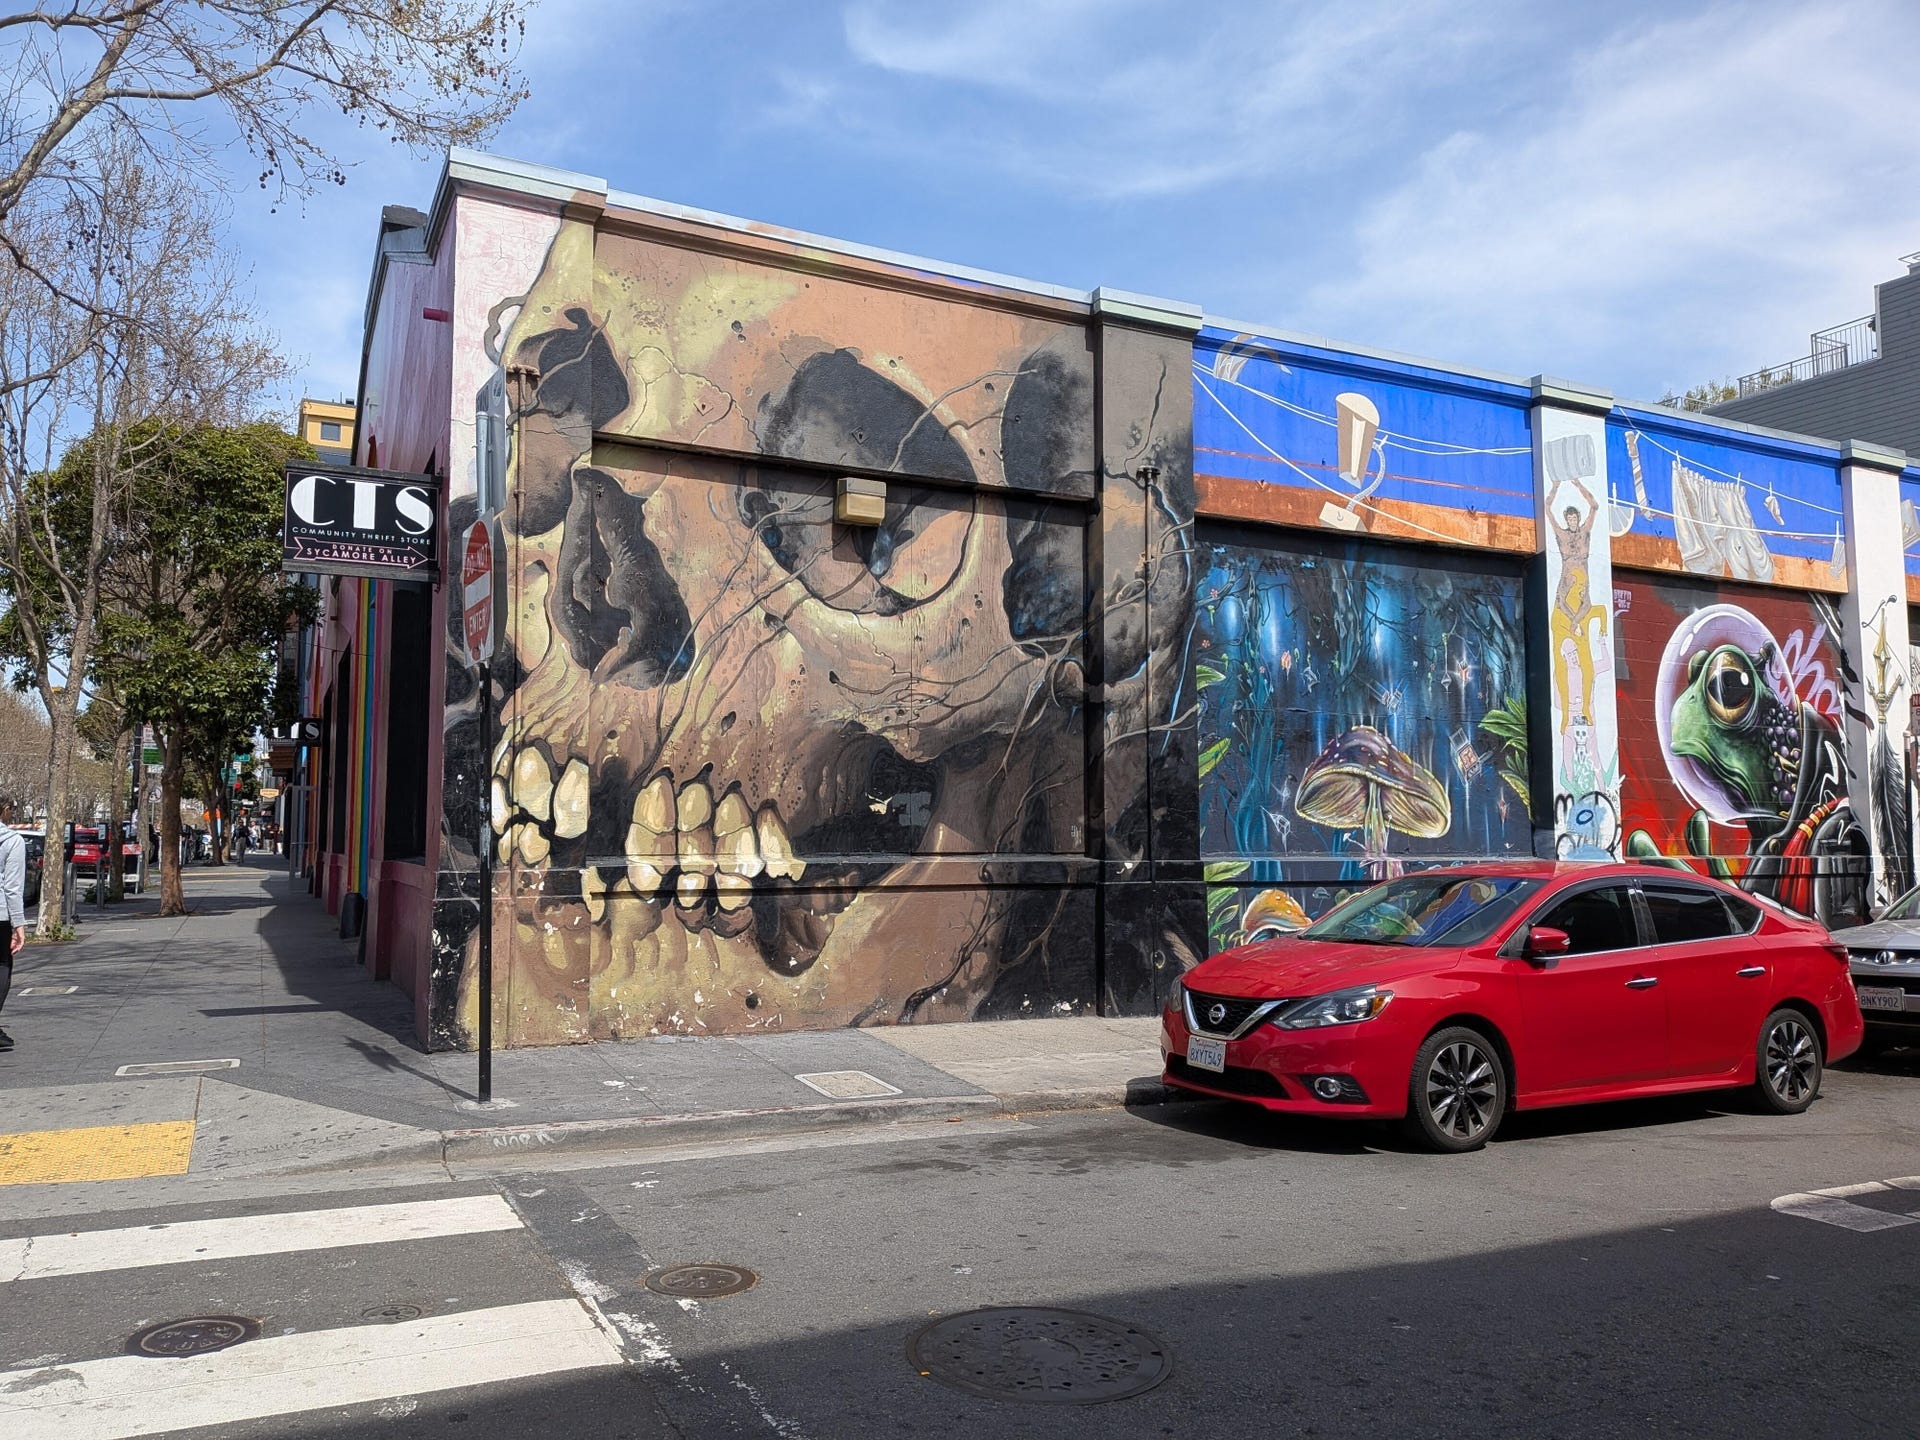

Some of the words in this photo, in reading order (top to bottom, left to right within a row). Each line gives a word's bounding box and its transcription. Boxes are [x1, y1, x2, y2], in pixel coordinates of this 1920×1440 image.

[291, 476, 434, 535] CTS
[292, 526, 356, 538] COMMUNITY
[362, 533, 395, 542] THRIFT
[400, 536, 431, 545] STORE
[307, 547, 376, 560] SYCAMORE
[381, 555, 417, 564] ALLEY
[332, 544, 373, 553] DONATE
[469, 607, 488, 636] ENTER
